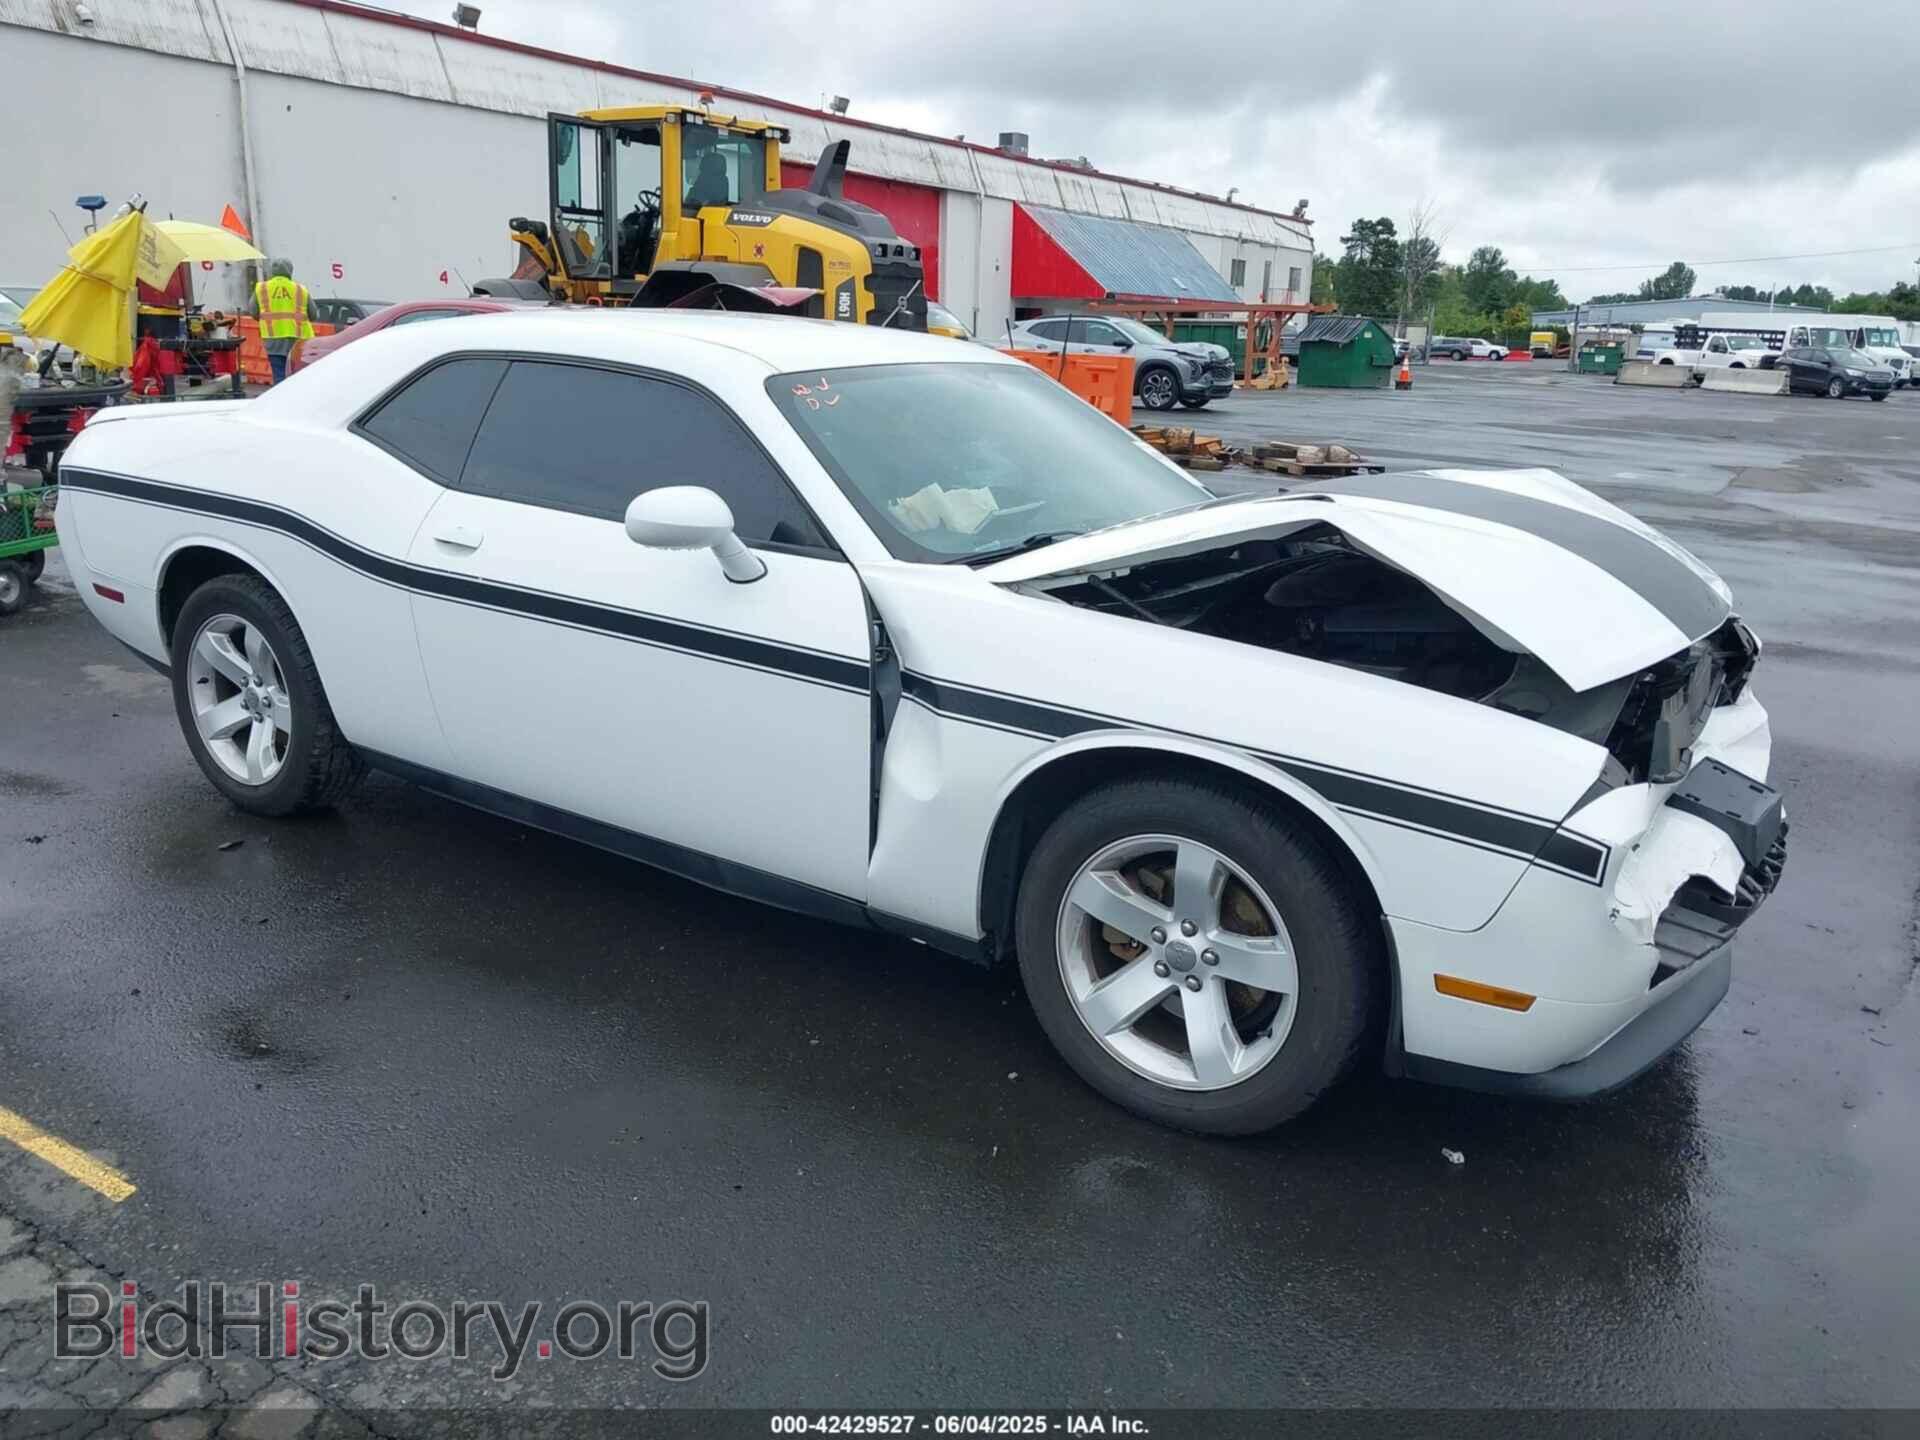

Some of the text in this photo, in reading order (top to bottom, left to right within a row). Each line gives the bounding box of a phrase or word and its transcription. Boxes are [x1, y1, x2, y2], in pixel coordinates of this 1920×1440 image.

[733, 212, 772, 224] VOLVO
[332, 263, 343, 279] 5
[439, 270, 448, 284] 4
[838, 291, 851, 317] L90H
